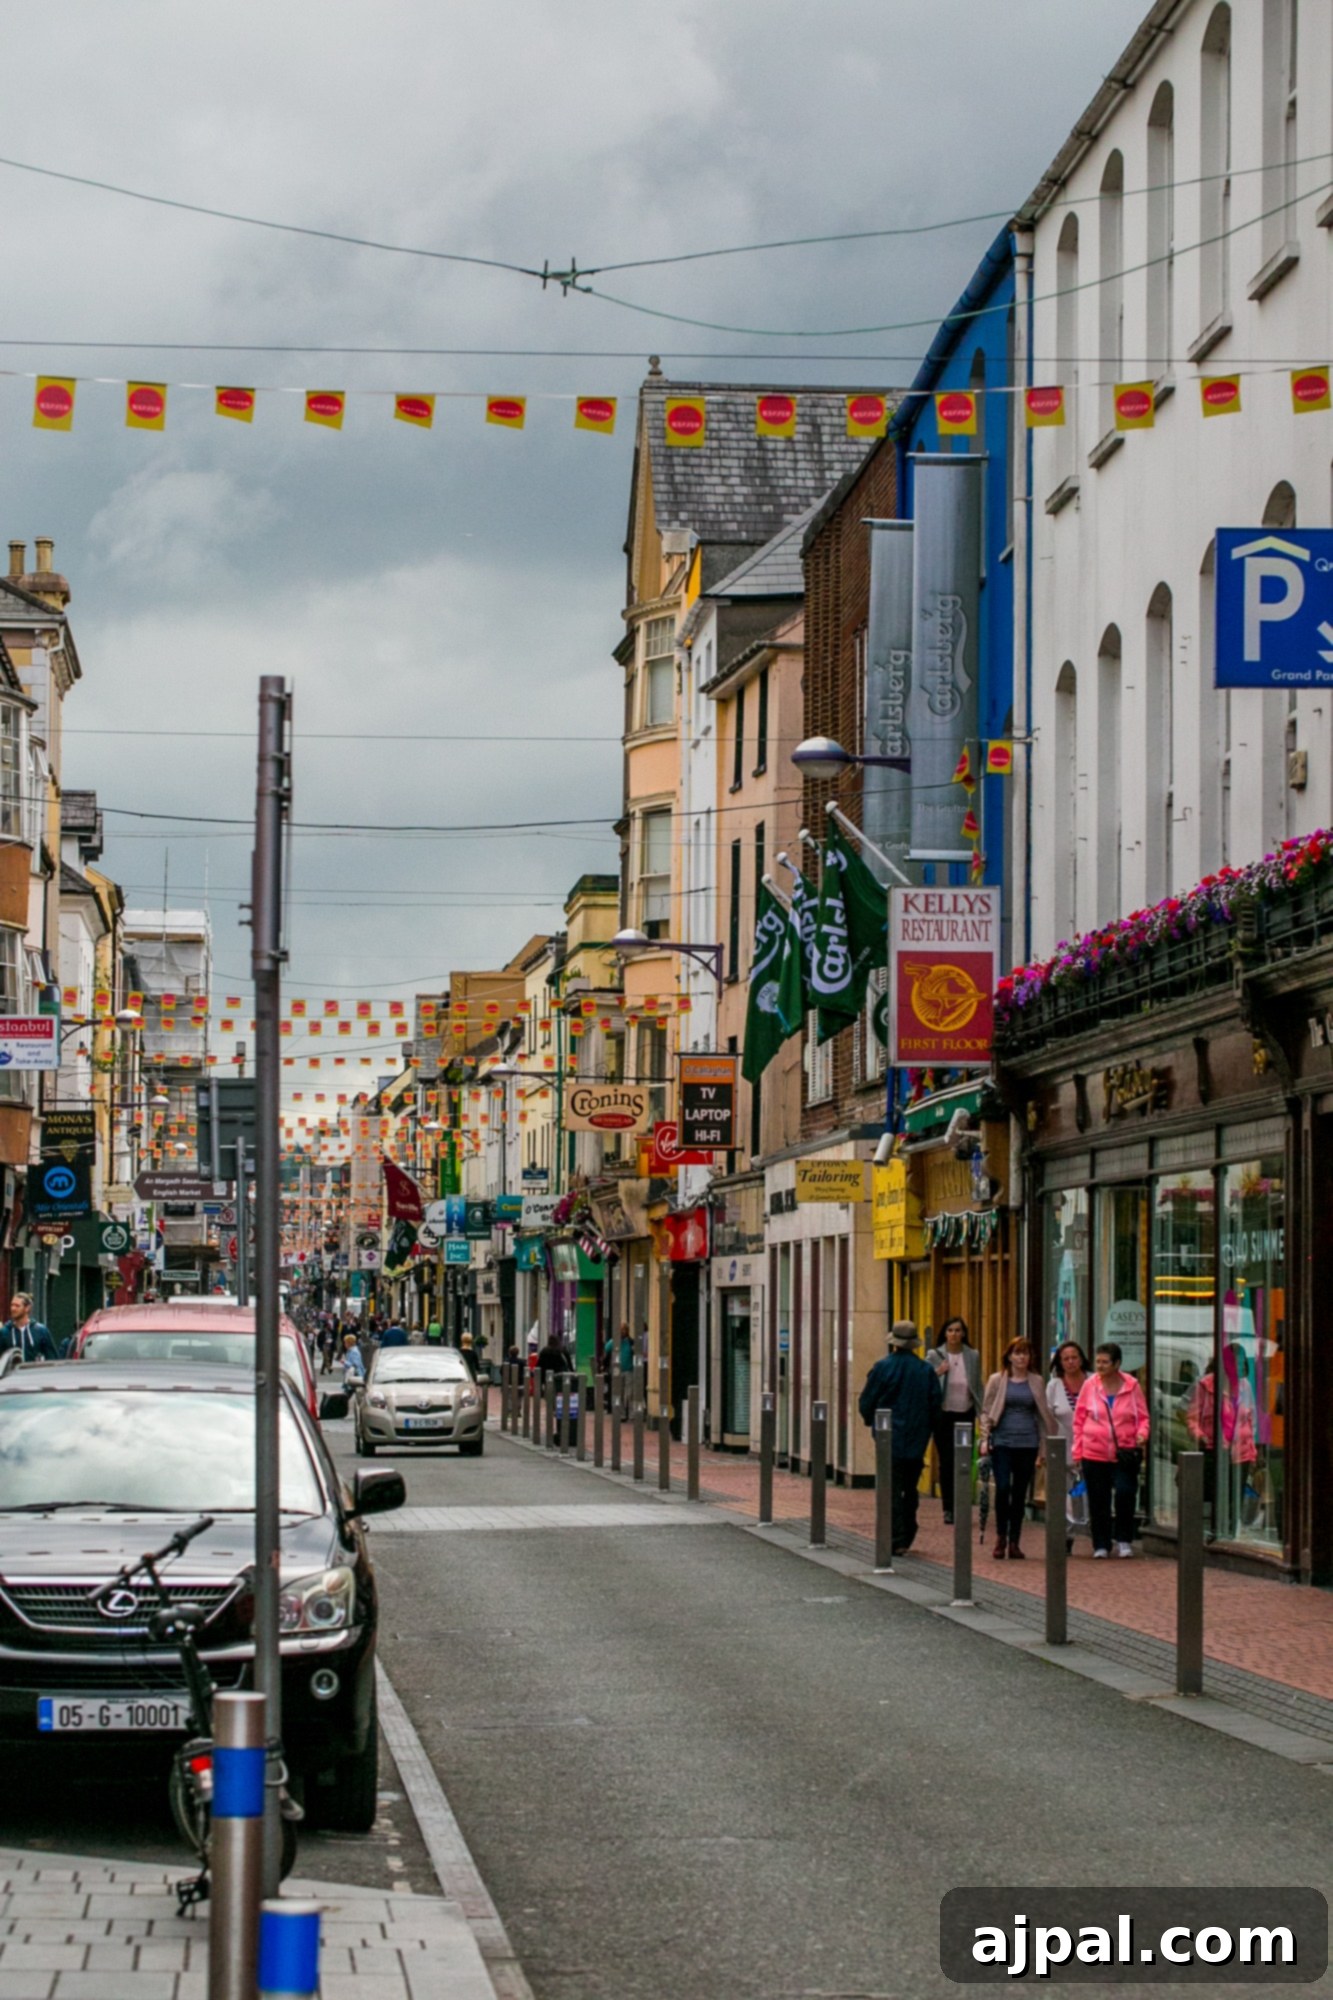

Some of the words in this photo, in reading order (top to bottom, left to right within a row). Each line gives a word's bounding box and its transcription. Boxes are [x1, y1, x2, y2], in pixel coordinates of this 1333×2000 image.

[1244, 556, 1305, 662] P
[921, 591, 962, 720] Carlsberg
[1271, 668, 1312, 681] Grand
[901, 892, 992, 917] KELLYS
[901, 918, 993, 943] RESTAURANT
[900, 1037, 938, 1051] FIRST
[942, 1037, 988, 1051] FLOOR
[700, 1087, 717, 1100] TV
[47, 1115, 92, 1125] MONA'S
[685, 1109, 732, 1122] LAPTOP
[46, 1126, 94, 1136] ANTIQUES
[694, 1129, 721, 1142] HI-FI
[811, 1160, 848, 1168] UPTOWN
[144, 1177, 154, 1185] An
[798, 1168, 862, 1187] Tailoring
[152, 1188, 178, 1198] English
[179, 1188, 202, 1197] Market
[1110, 1311, 1146, 1322] CASEYS
